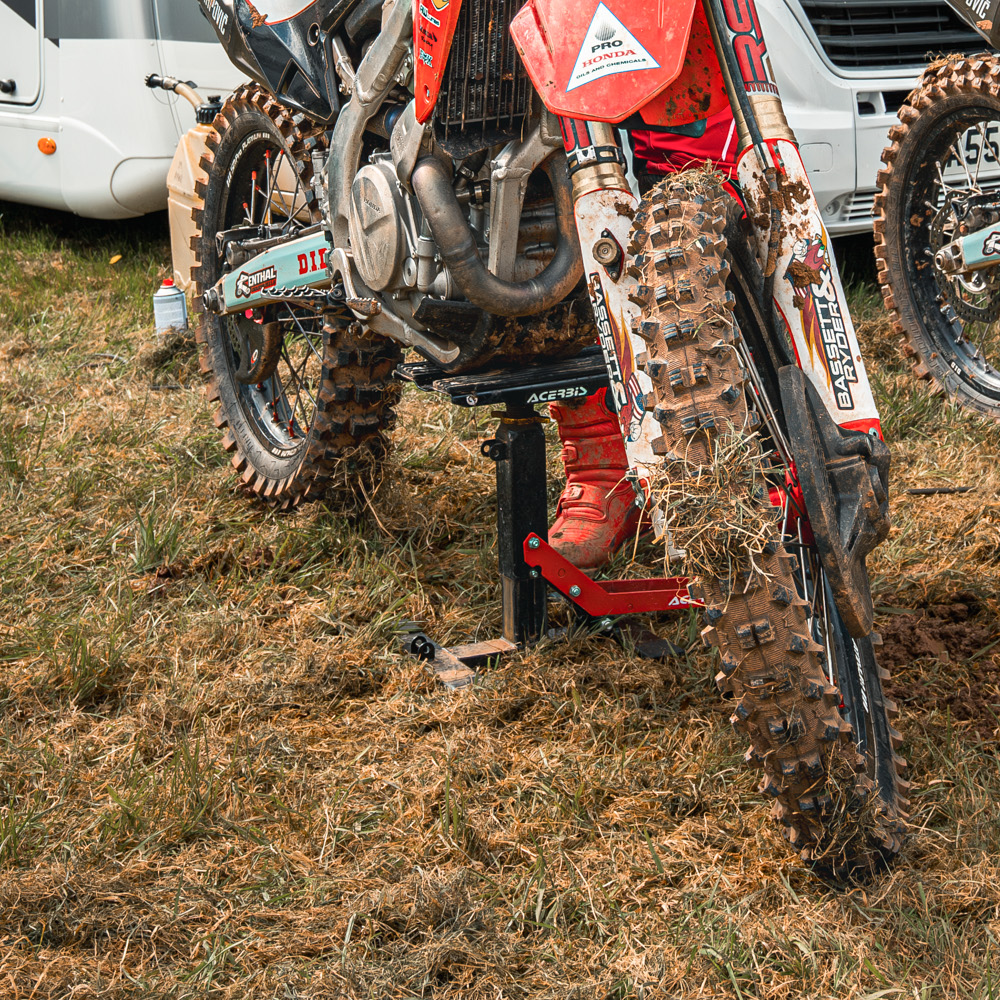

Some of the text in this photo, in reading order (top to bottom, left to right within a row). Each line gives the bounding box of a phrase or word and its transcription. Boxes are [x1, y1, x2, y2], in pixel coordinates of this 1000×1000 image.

[591, 39, 624, 54] PRO
[576, 57, 647, 80] OILS AND CHEMICALS
[582, 48, 637, 69] HONDA
[812, 268, 853, 409] BASSETT &
[827, 300, 857, 382] RYDER
[527, 386, 588, 404] ACERBIS
